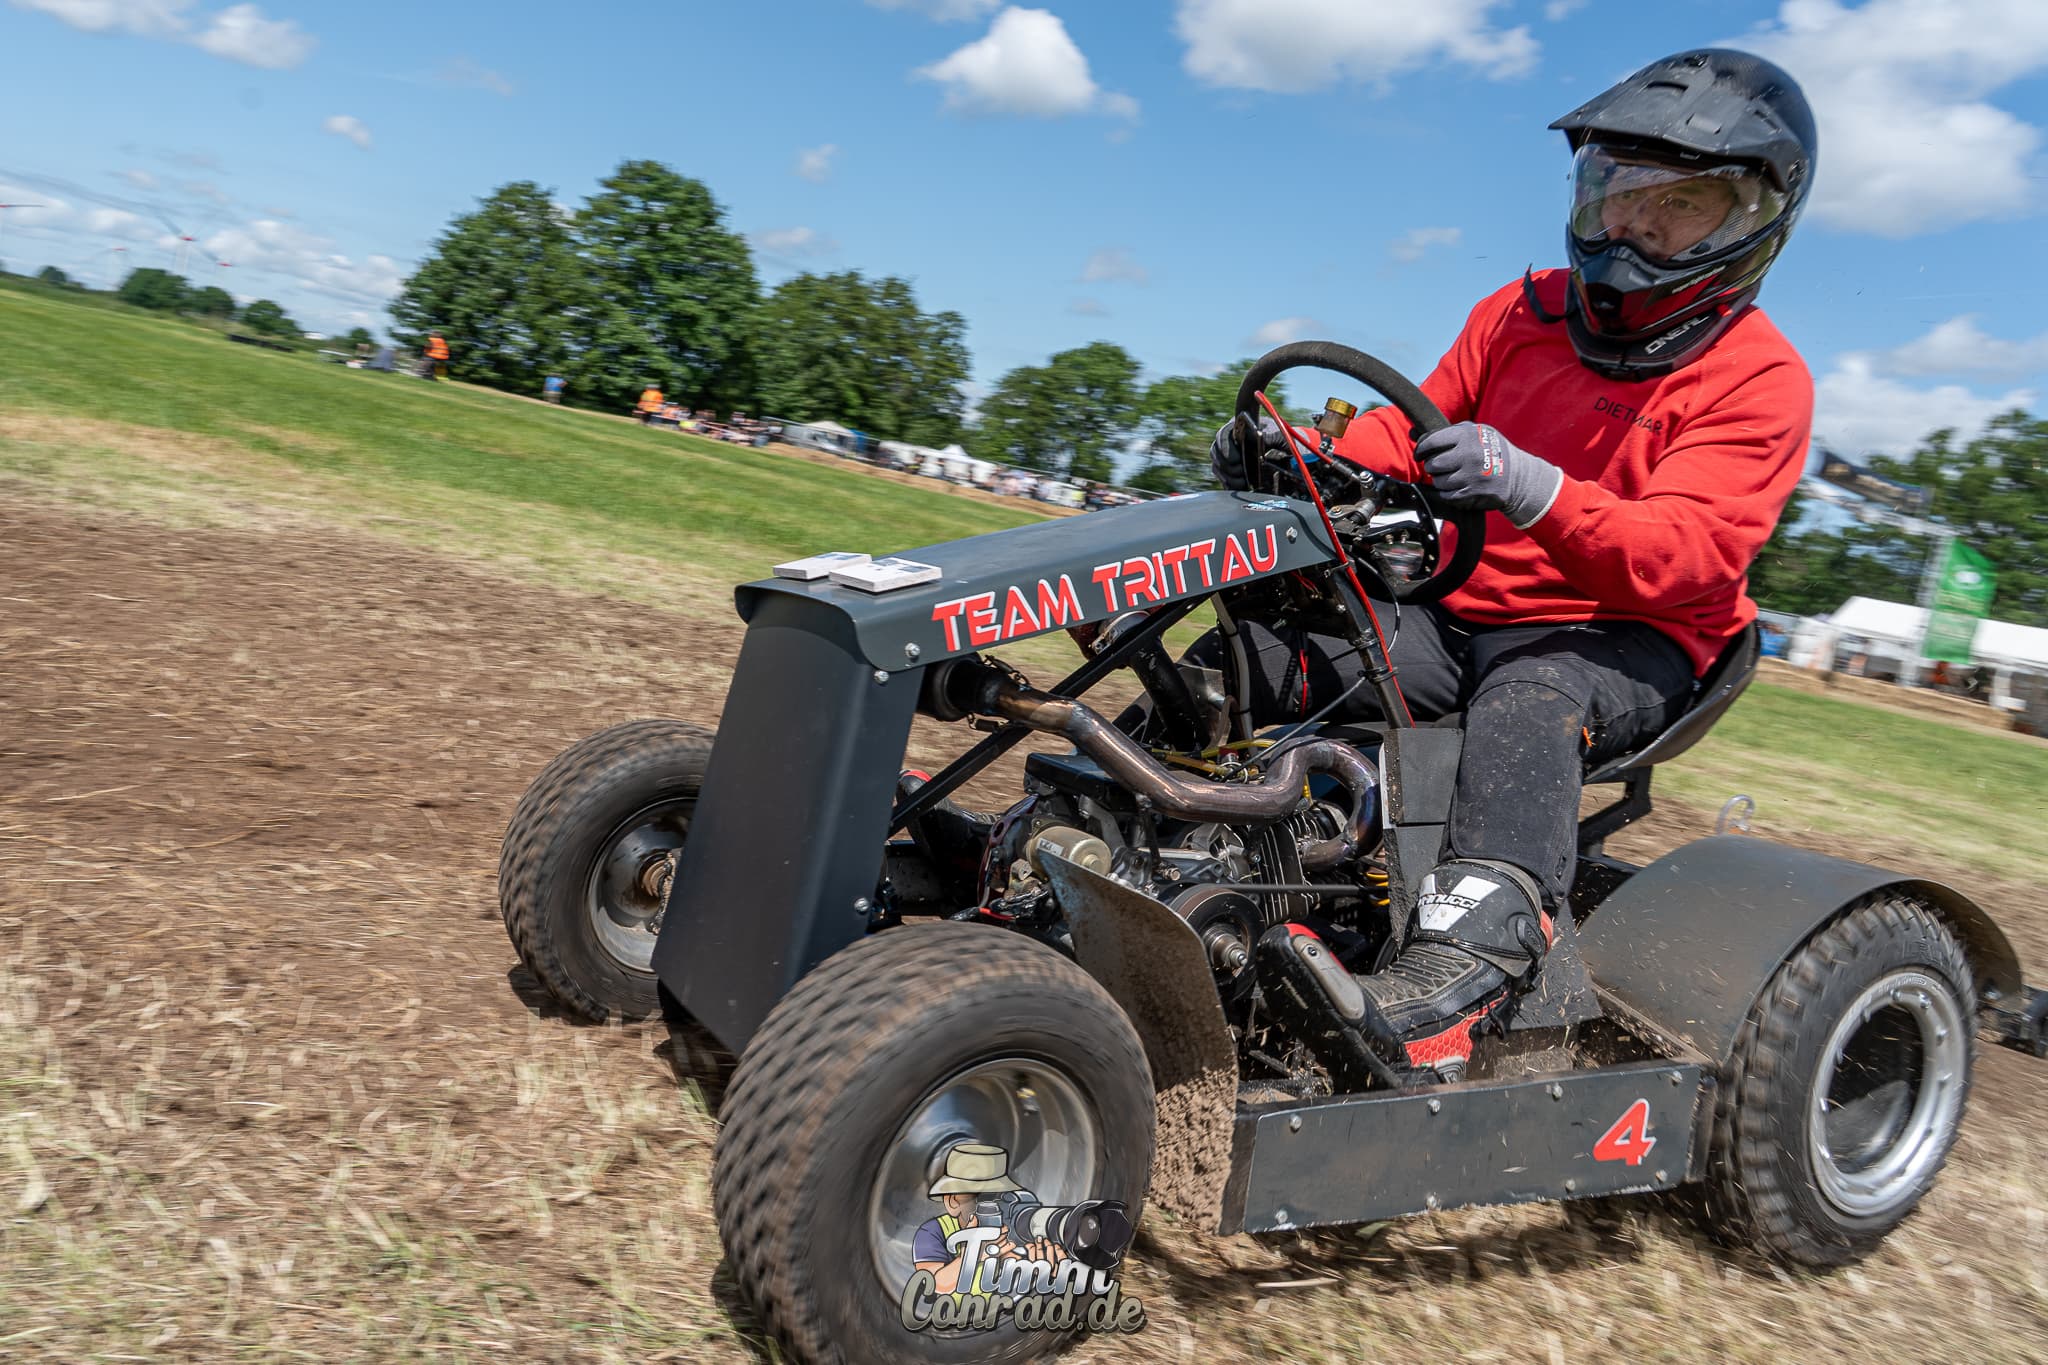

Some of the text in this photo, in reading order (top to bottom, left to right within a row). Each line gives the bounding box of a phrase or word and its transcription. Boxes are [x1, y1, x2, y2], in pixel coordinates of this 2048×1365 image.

[1594, 396, 1663, 436] DIETMAR
[931, 524, 1278, 652] TEAM TRITTAU
[1593, 1098, 1657, 1166] 4
